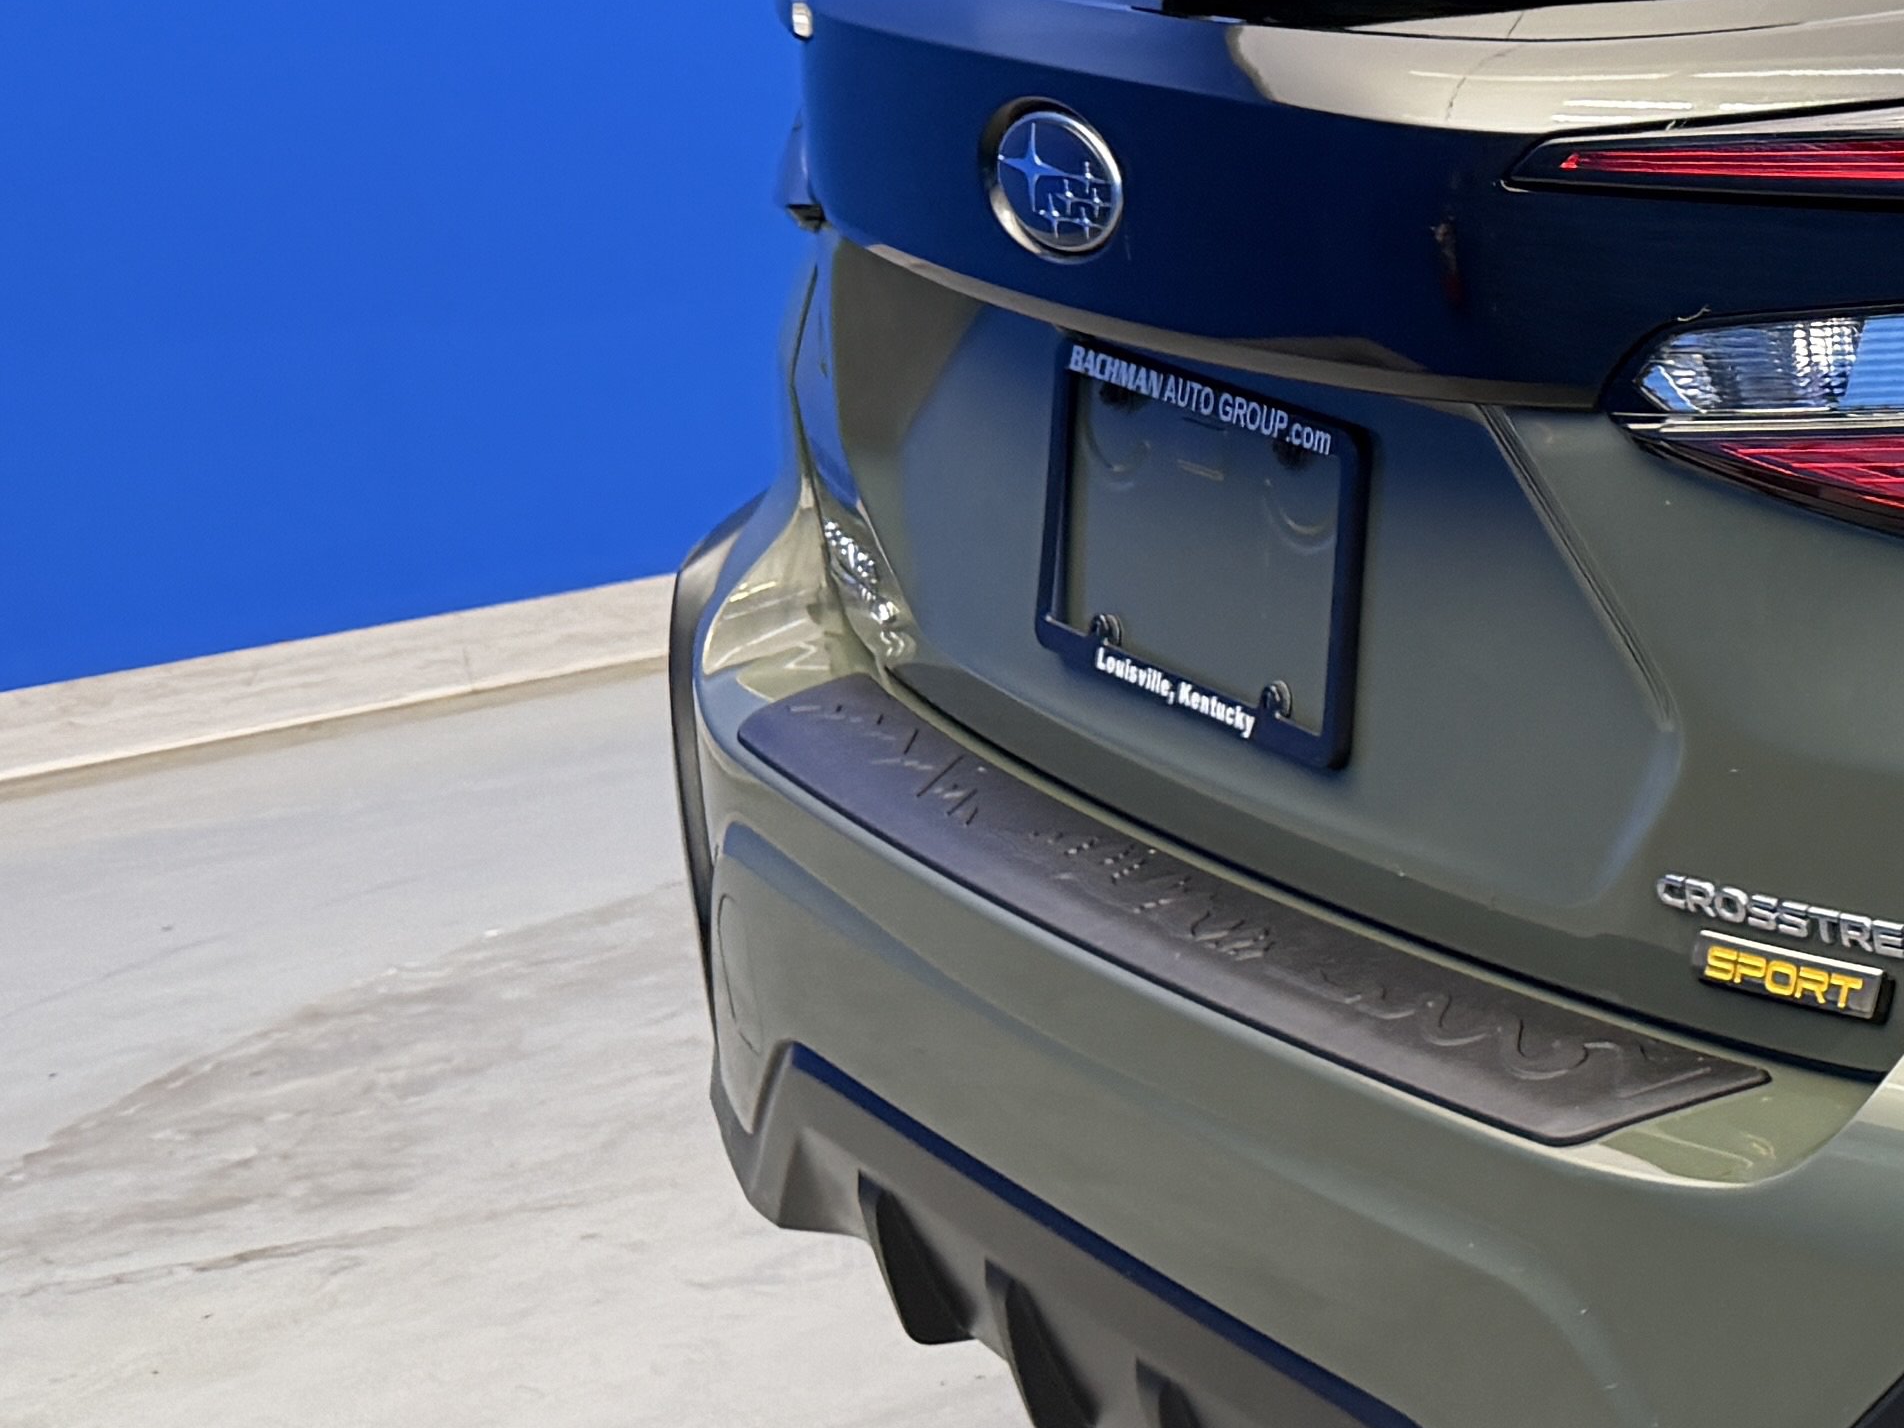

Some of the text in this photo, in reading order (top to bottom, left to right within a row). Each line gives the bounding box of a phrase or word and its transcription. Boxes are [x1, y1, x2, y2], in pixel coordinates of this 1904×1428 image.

[1068, 345, 1332, 456] BACHMAN AUTO GROUP.com
[1095, 647, 1256, 739] Louisville, Kentucky
[1703, 945, 1864, 1009] SPORT
